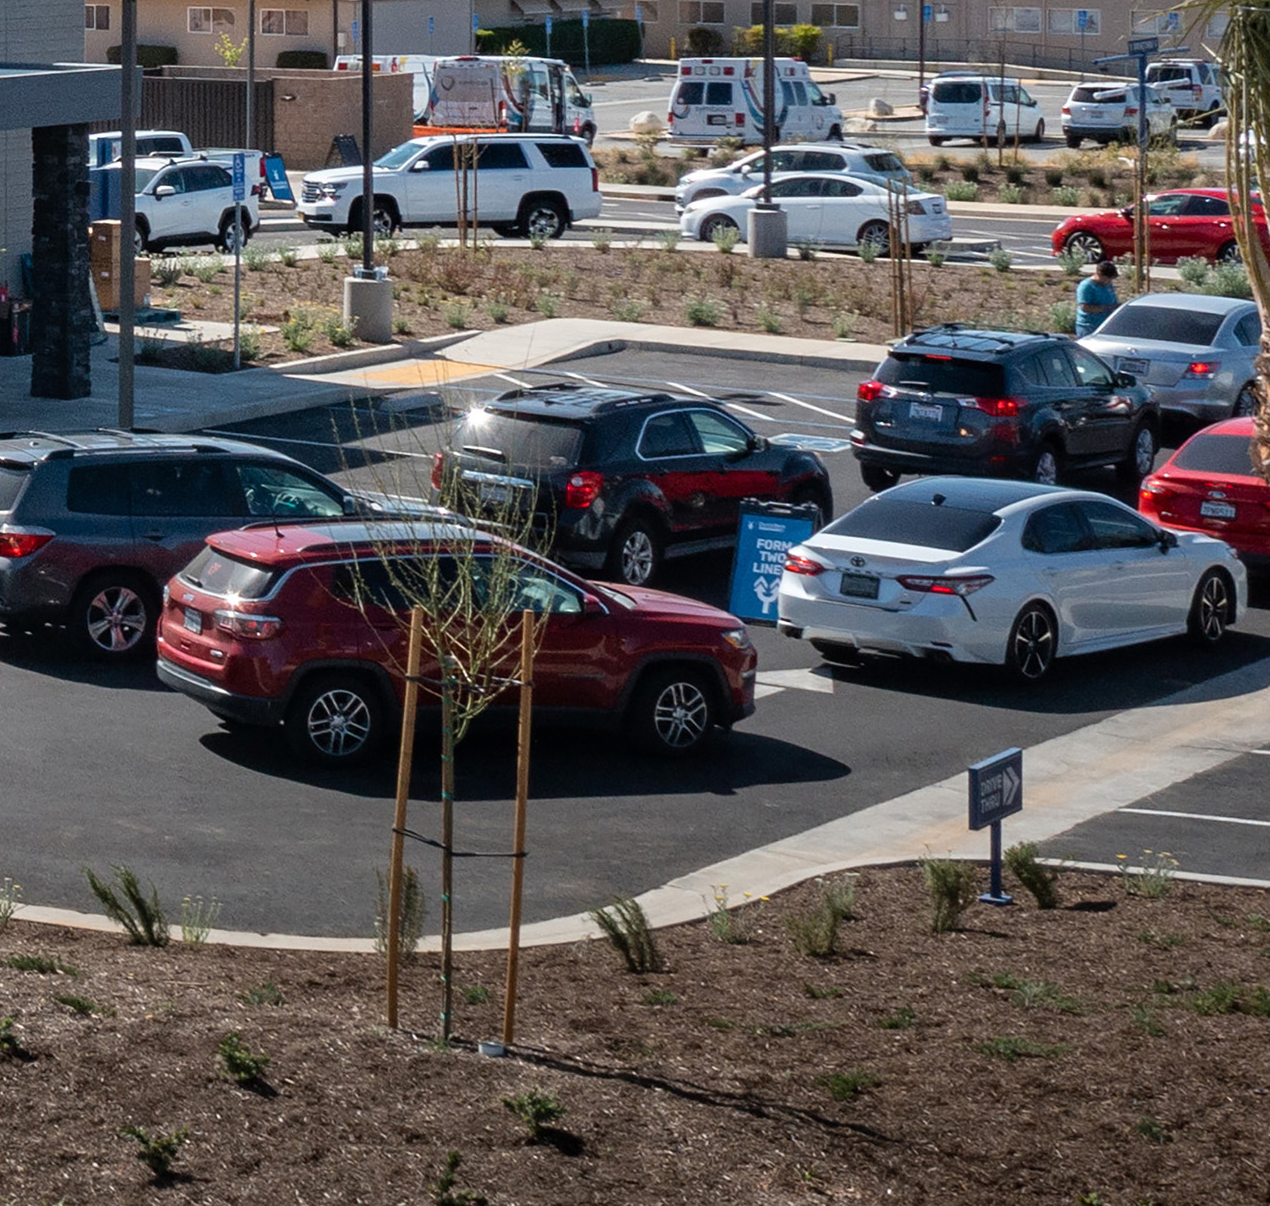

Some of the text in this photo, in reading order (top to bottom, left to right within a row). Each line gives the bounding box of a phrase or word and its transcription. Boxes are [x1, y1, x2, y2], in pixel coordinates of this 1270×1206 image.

[756, 538, 792, 551] FORM
[759, 551, 787, 564] TWO
[981, 774, 1002, 796] DRIVE
[981, 792, 1000, 814] THRU
